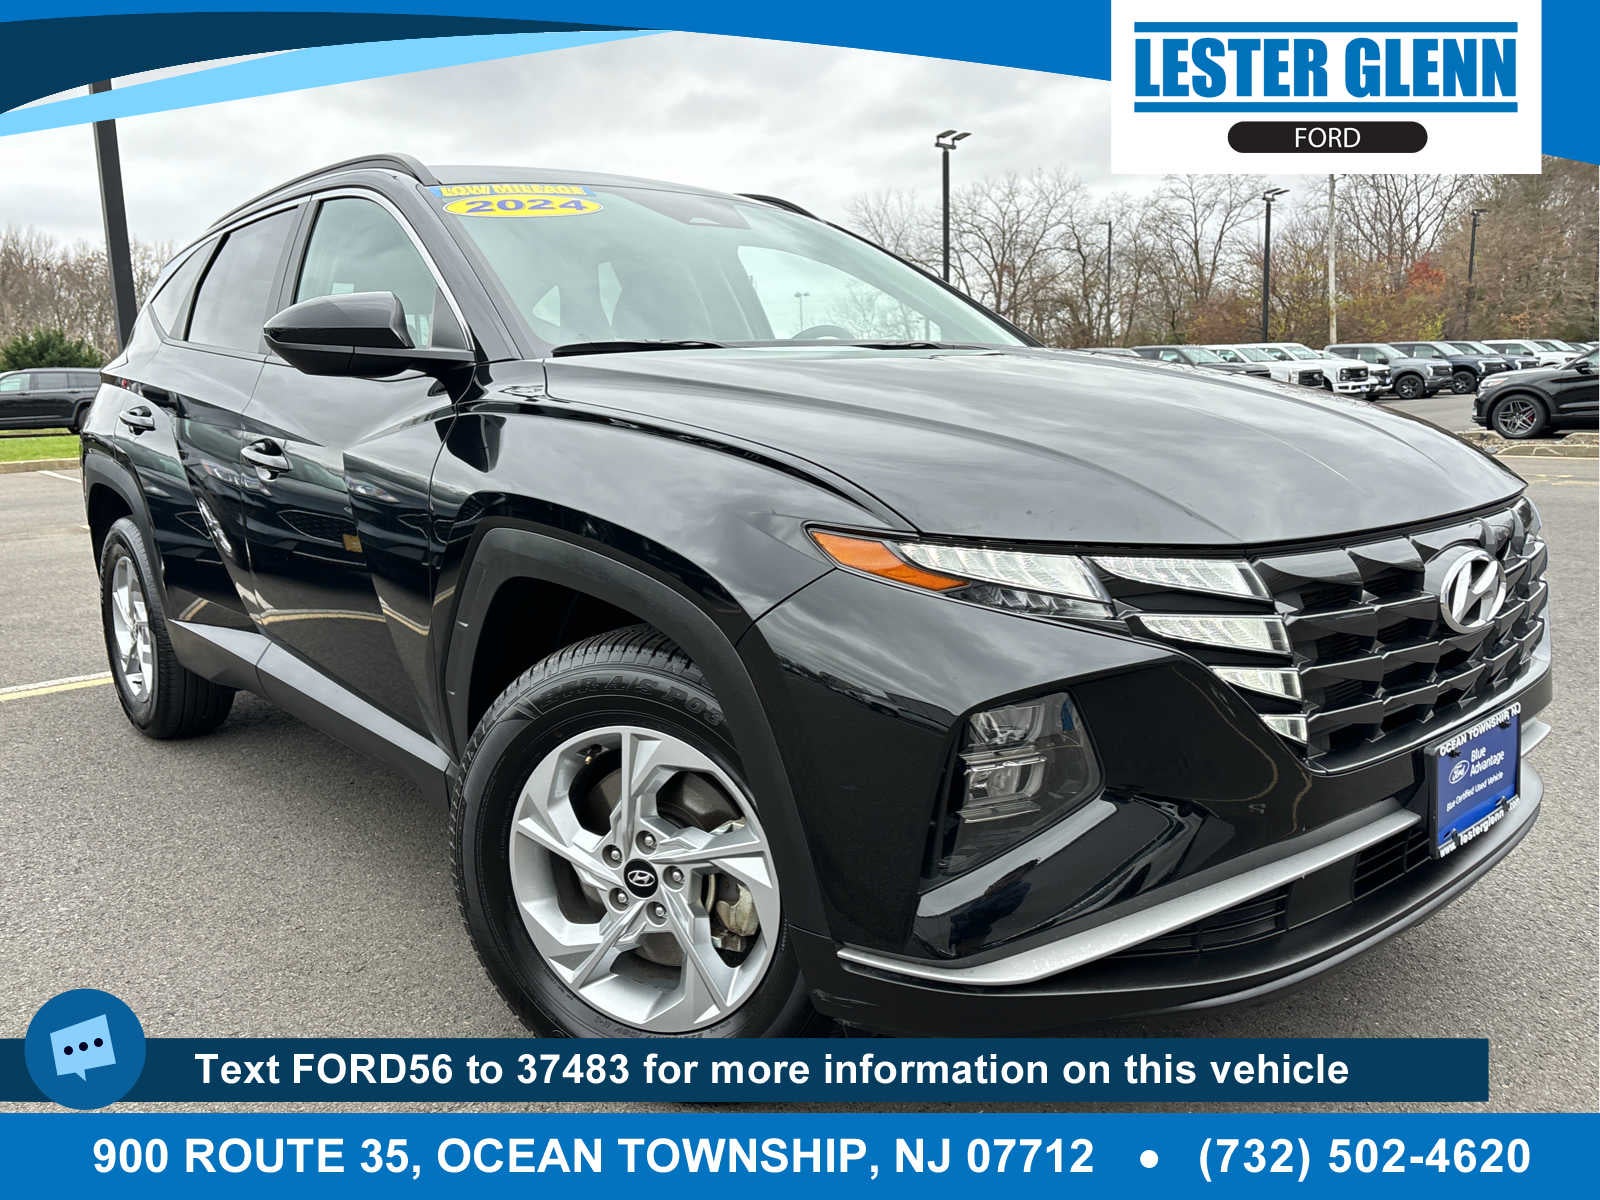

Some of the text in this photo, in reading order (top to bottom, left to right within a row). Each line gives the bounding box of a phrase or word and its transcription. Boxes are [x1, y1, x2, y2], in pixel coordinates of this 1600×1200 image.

[441, 184, 586, 197] LOW MILEAGE
[465, 199, 588, 213] 2024
[1440, 732, 1467, 756] OCEAN
[1471, 747, 1486, 762] Blue
[1470, 750, 1504, 777] Advantage
